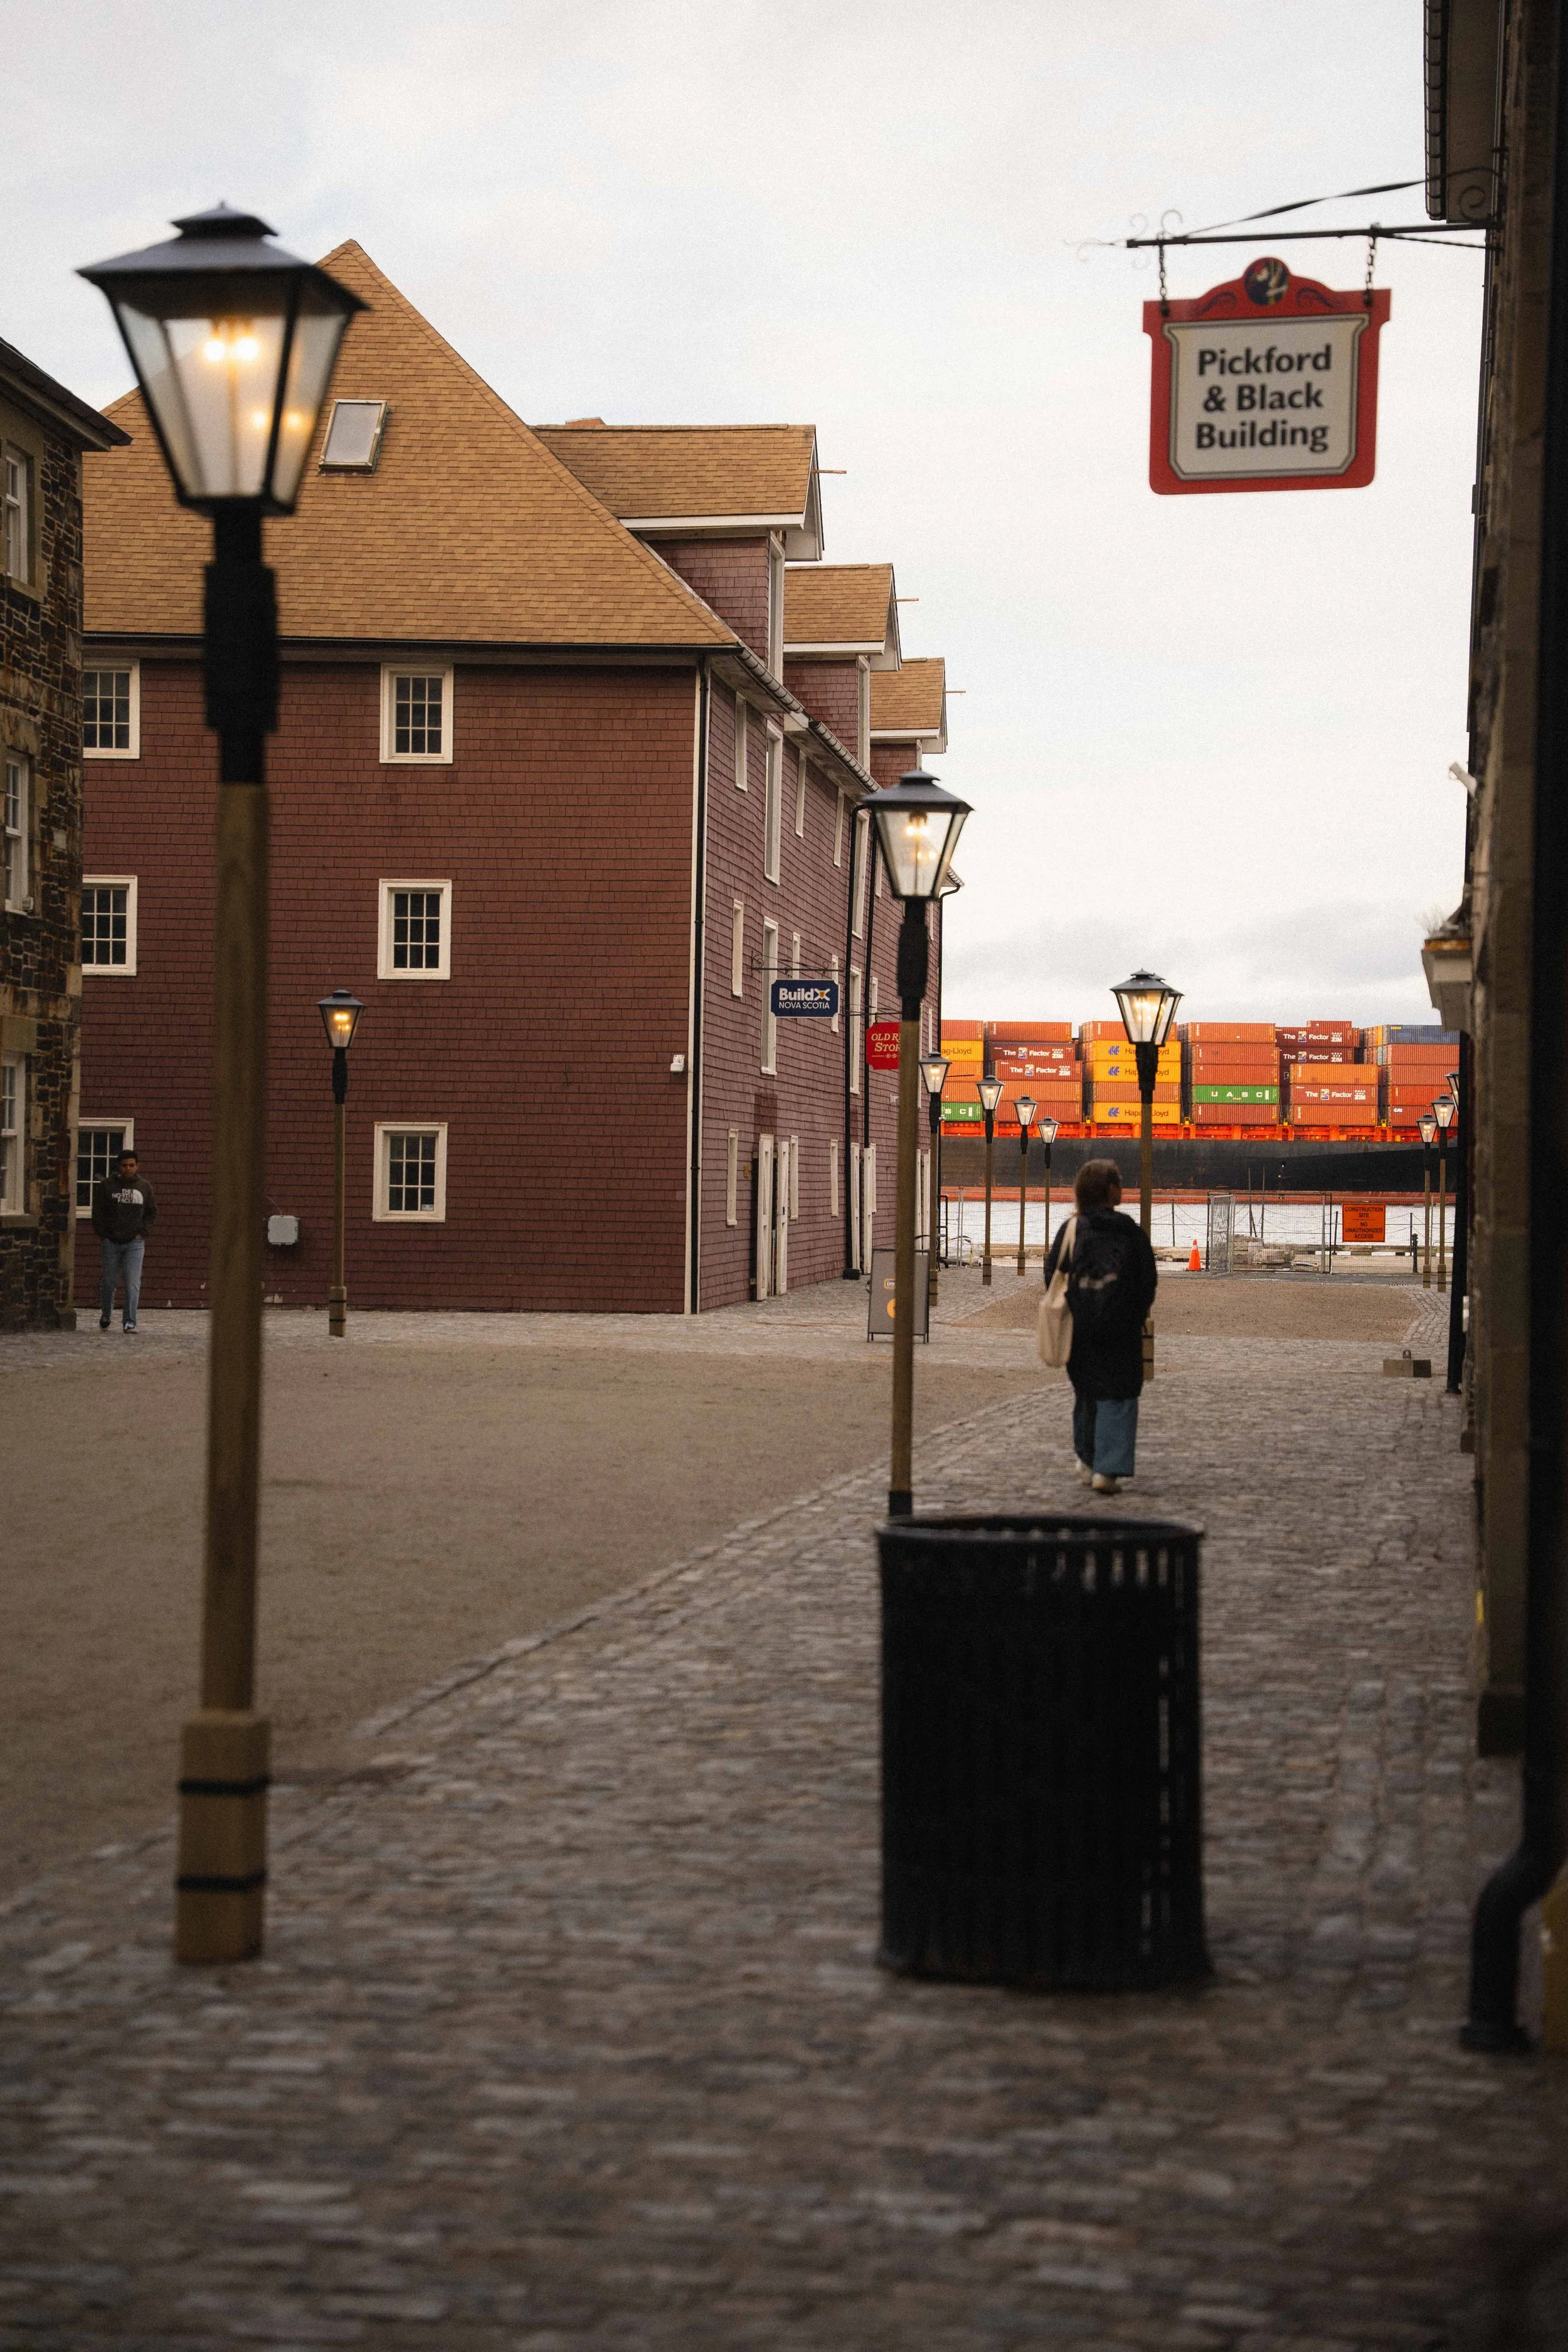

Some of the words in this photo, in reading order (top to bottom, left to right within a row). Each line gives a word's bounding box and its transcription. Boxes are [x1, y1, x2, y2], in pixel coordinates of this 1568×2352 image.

[1199, 344, 1332, 375] Pickford
[1204, 385, 1226, 411] &
[1237, 381, 1323, 411] Black
[1197, 419, 1330, 453] Building
[871, 1033, 891, 1041] OLD
[891, 1033, 901, 1043] R
[874, 1042, 901, 1052] STOR
[941, 1047, 972, 1056] ag-Lloyd
